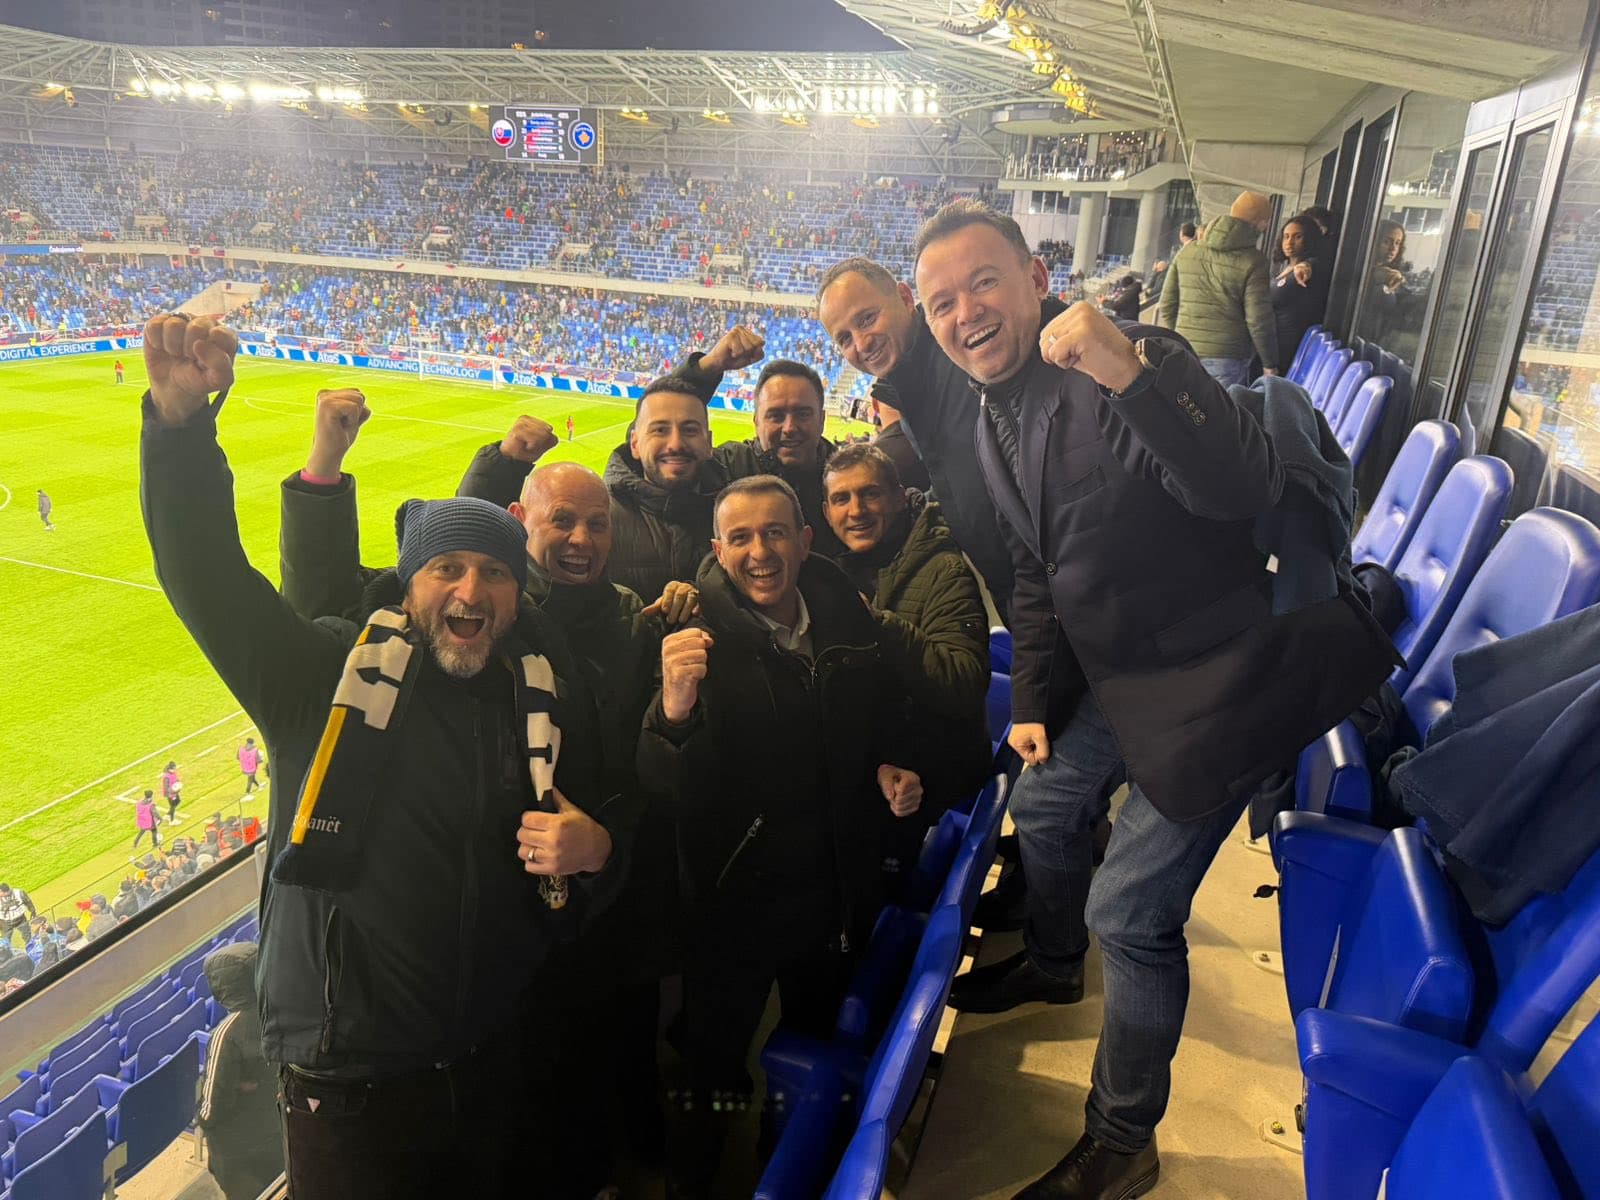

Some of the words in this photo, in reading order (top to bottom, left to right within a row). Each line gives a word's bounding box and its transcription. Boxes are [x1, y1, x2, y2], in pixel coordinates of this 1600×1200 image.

[0, 347, 39, 361] DIGITAL
[40, 342, 97, 356] EXPERIENCE
[367, 357, 419, 372] ADVANCING
